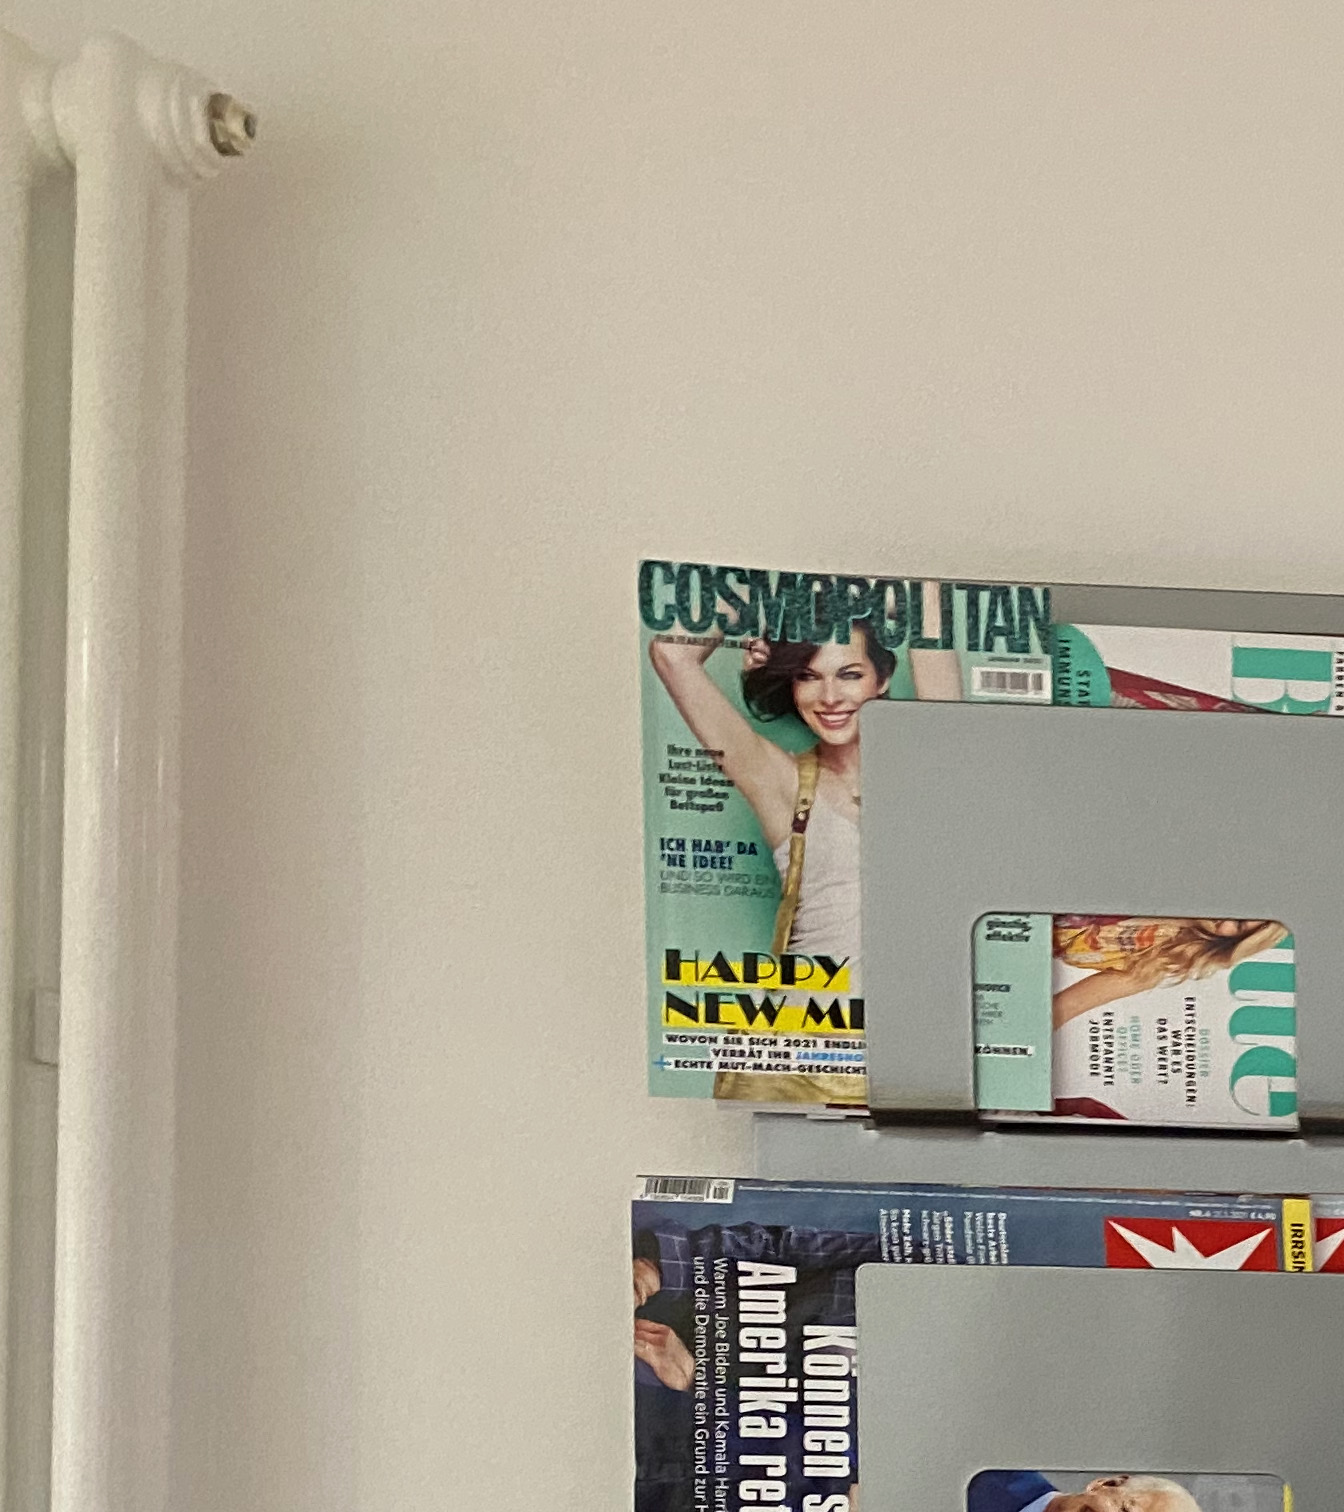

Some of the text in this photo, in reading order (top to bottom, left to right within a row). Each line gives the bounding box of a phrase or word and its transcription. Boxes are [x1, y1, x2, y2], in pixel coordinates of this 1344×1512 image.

[639, 559, 1053, 654] COSMOPOLITAN
[1058, 639, 1072, 705] IMMUN
[660, 837, 687, 853] ICH
[737, 842, 759, 856] DA
[665, 948, 850, 988] HAPPY
[666, 991, 787, 1027] NEW
[694, 1257, 709, 1284] und
[713, 1258, 730, 1309] Warum
[694, 1288, 709, 1311] die
[713, 1313, 730, 1339] Joe
[694, 1315, 709, 1398] Demokratie
[713, 1343, 730, 1384] Biden
[737, 1261, 798, 1438] Amerika
[694, 1403, 709, 1424] ein
[713, 1388, 730, 1416] und
[803, 1325, 858, 1478] Können
[694, 1428, 709, 1473] Grund
[713, 1421, 730, 1473] Kamala
[694, 1478, 709, 1501] zur
